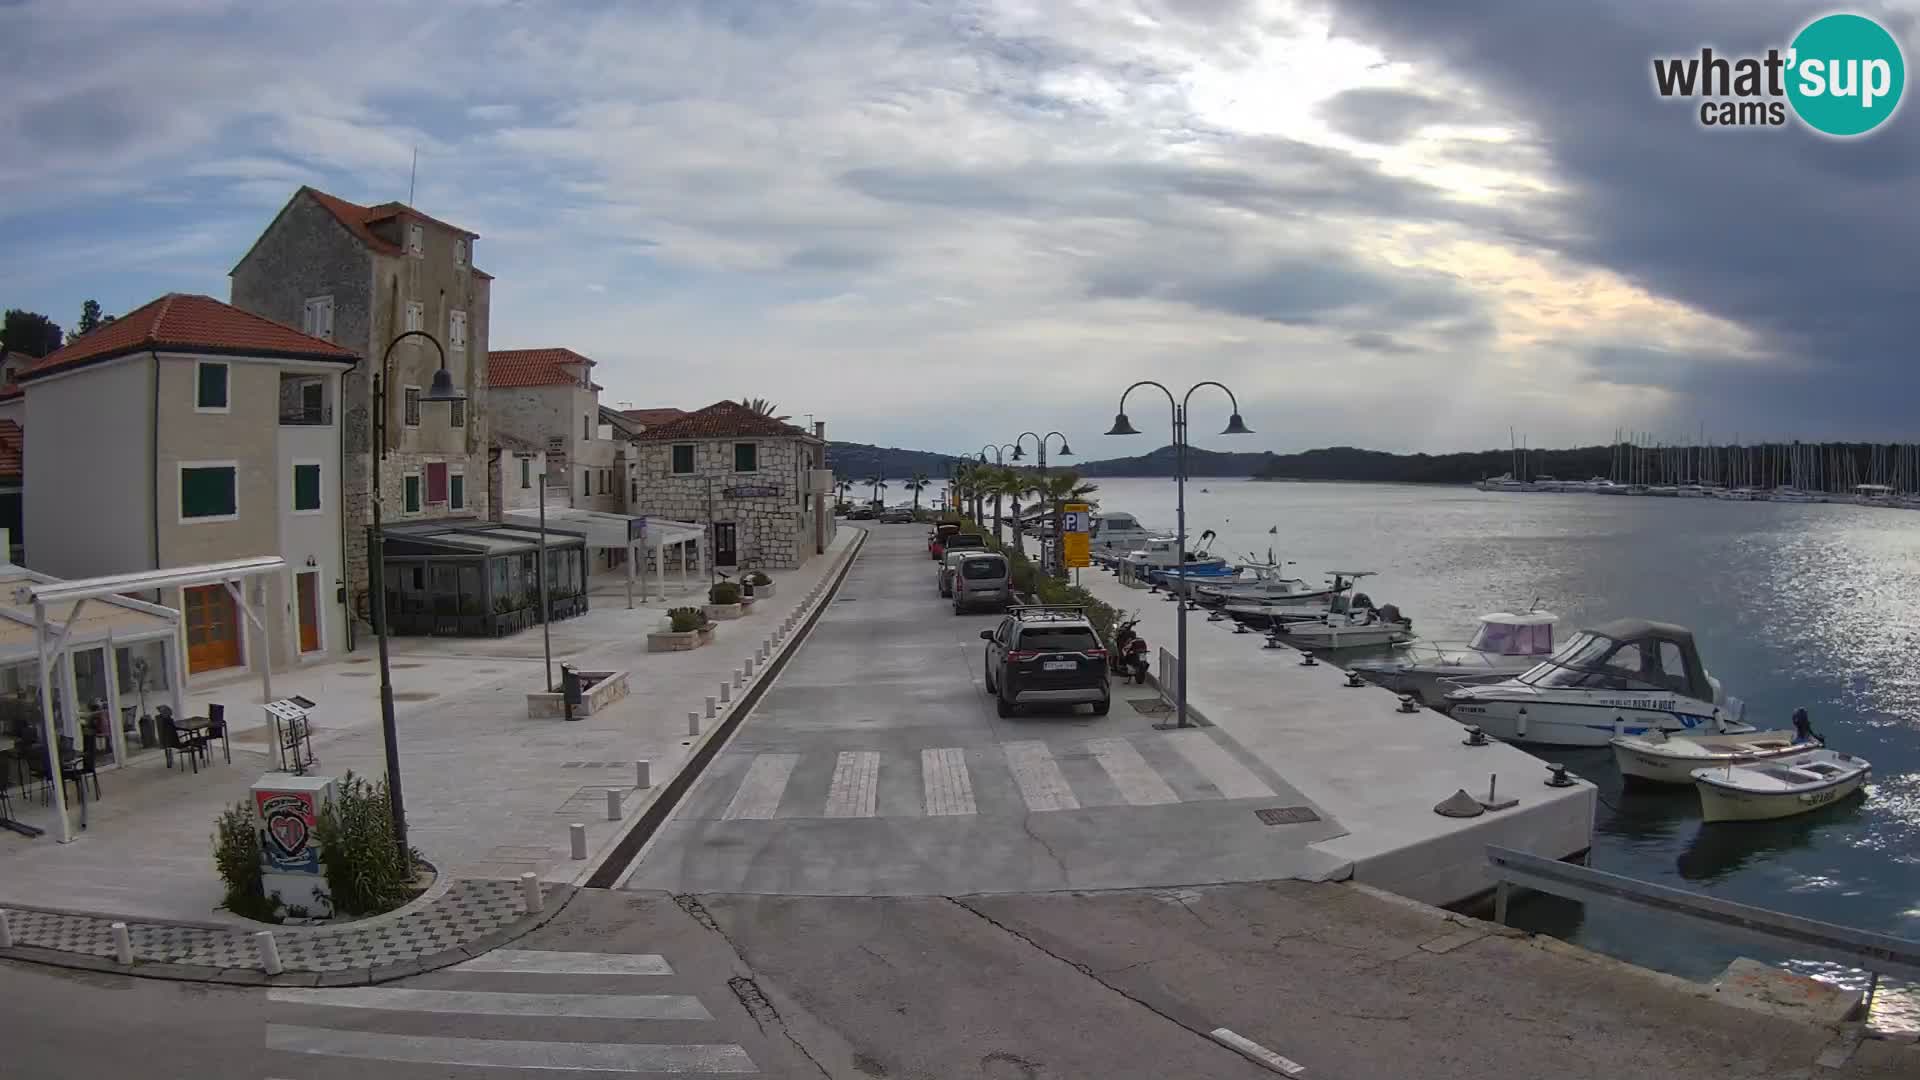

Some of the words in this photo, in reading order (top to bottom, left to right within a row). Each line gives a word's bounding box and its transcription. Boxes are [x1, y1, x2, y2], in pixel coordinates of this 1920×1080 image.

[1066, 514, 1077, 530] P
[1632, 699, 1651, 709] RENT
[1658, 700, 1676, 711] BOAT
